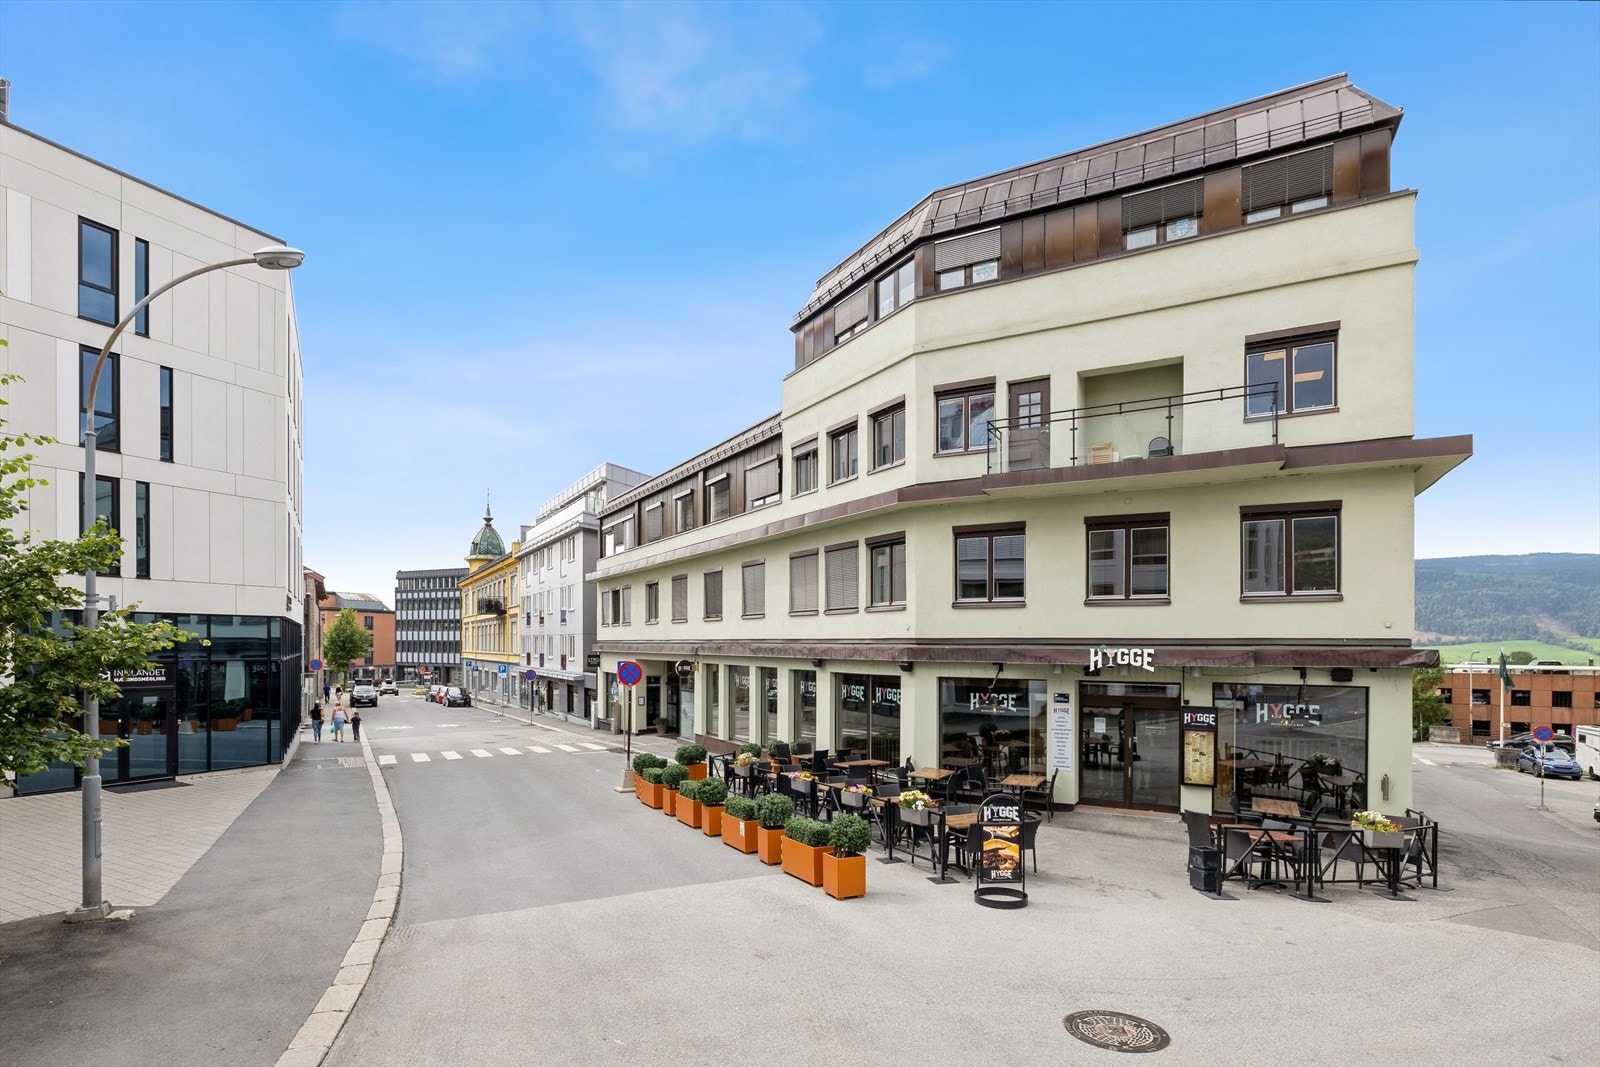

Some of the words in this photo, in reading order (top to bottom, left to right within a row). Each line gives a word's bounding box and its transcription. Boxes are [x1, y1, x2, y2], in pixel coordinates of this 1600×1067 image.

[1089, 648, 1155, 673] HYGGE
[841, 684, 865, 702] HYGGE
[1183, 712, 1216, 726] HYGGE
[983, 806, 1021, 822] HYGGE
[991, 870, 1013, 879] HYGGE
